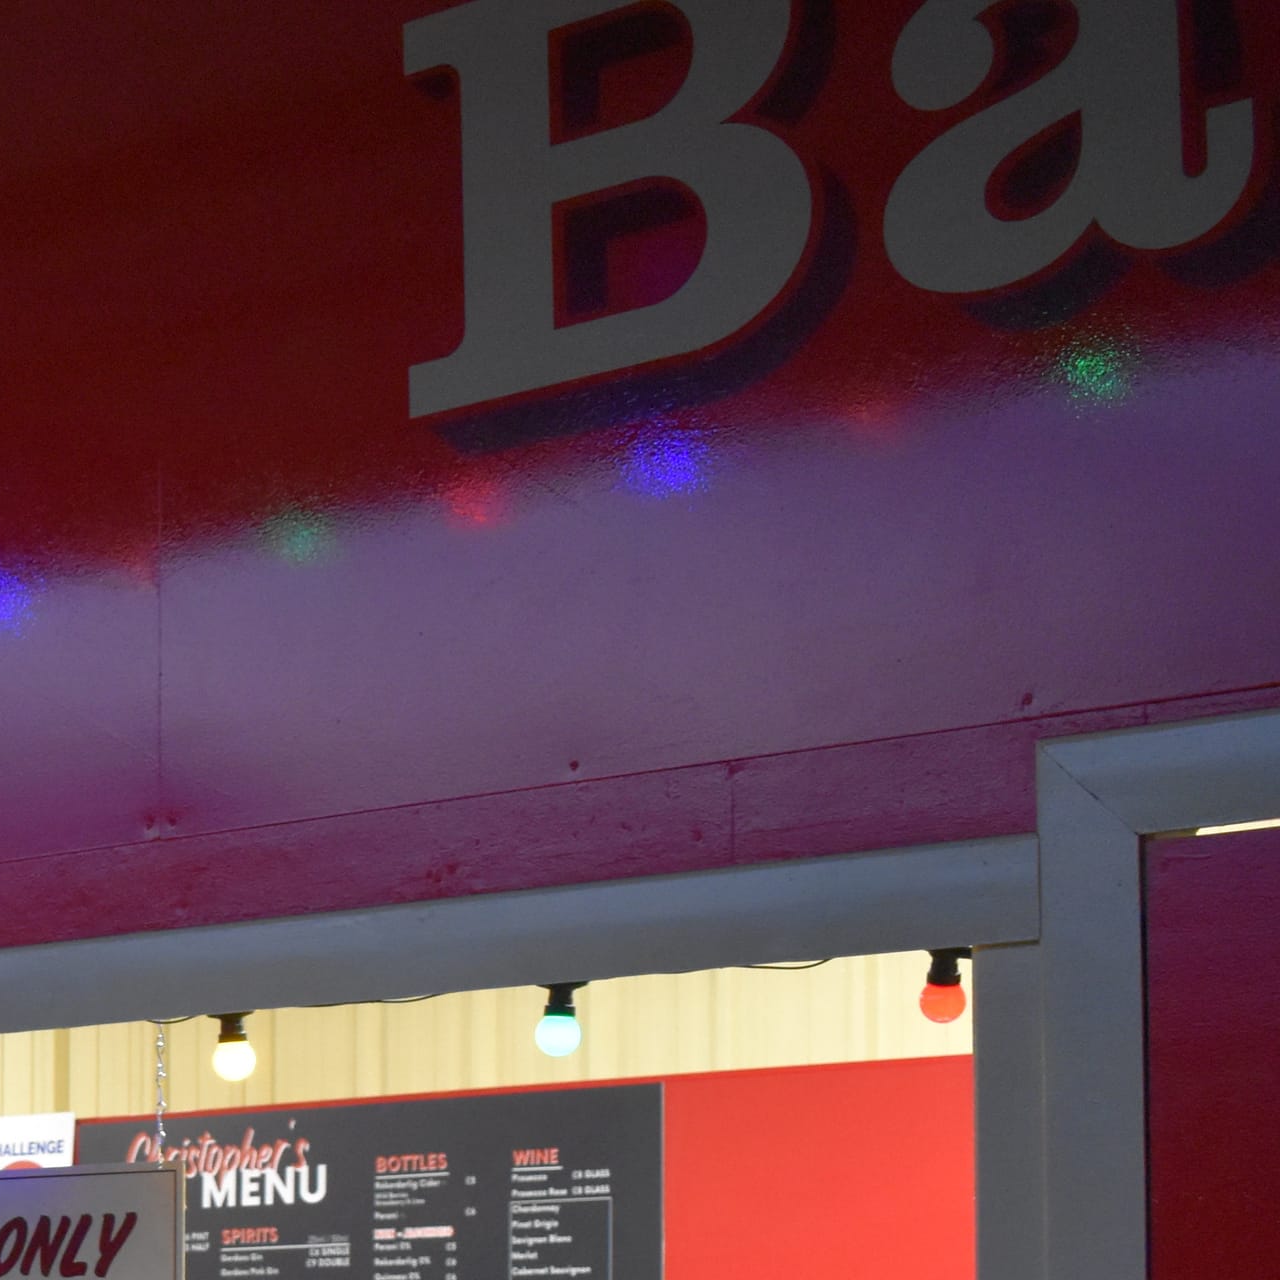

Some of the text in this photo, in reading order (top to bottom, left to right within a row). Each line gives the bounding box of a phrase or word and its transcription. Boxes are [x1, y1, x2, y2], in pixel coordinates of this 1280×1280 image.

[375, 1153, 448, 1172] BOTTLES
[513, 1149, 559, 1165] WINE
[201, 1164, 328, 1208] MENU
[221, 1227, 278, 1244] SPIRITS
